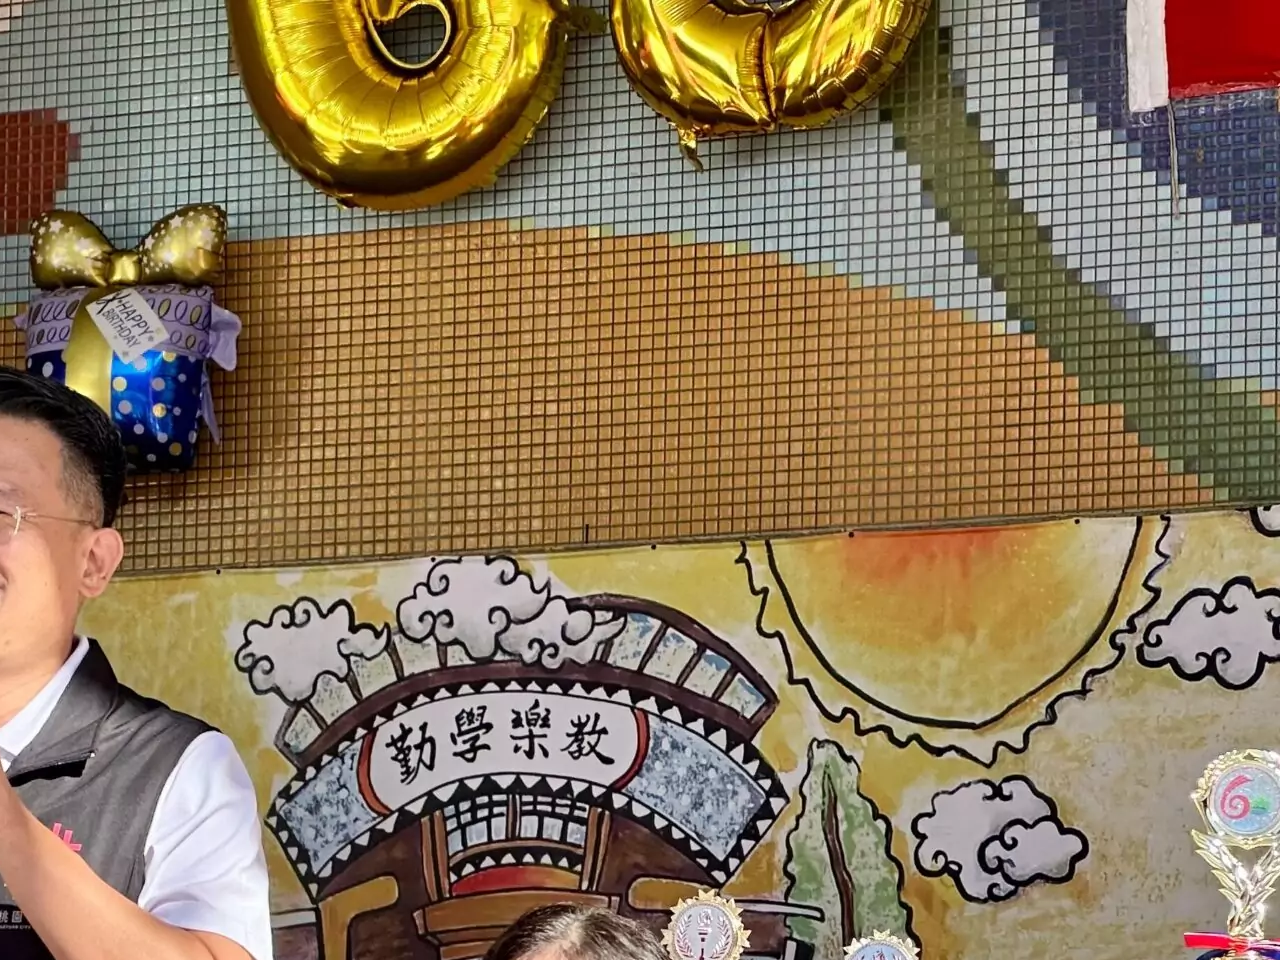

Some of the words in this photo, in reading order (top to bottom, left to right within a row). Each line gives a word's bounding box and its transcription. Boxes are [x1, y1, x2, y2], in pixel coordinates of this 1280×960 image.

[102, 308, 141, 348] BIRTHDAY
[117, 301, 154, 337] HAPPY
[385, 699, 615, 785] 勤學樂教
